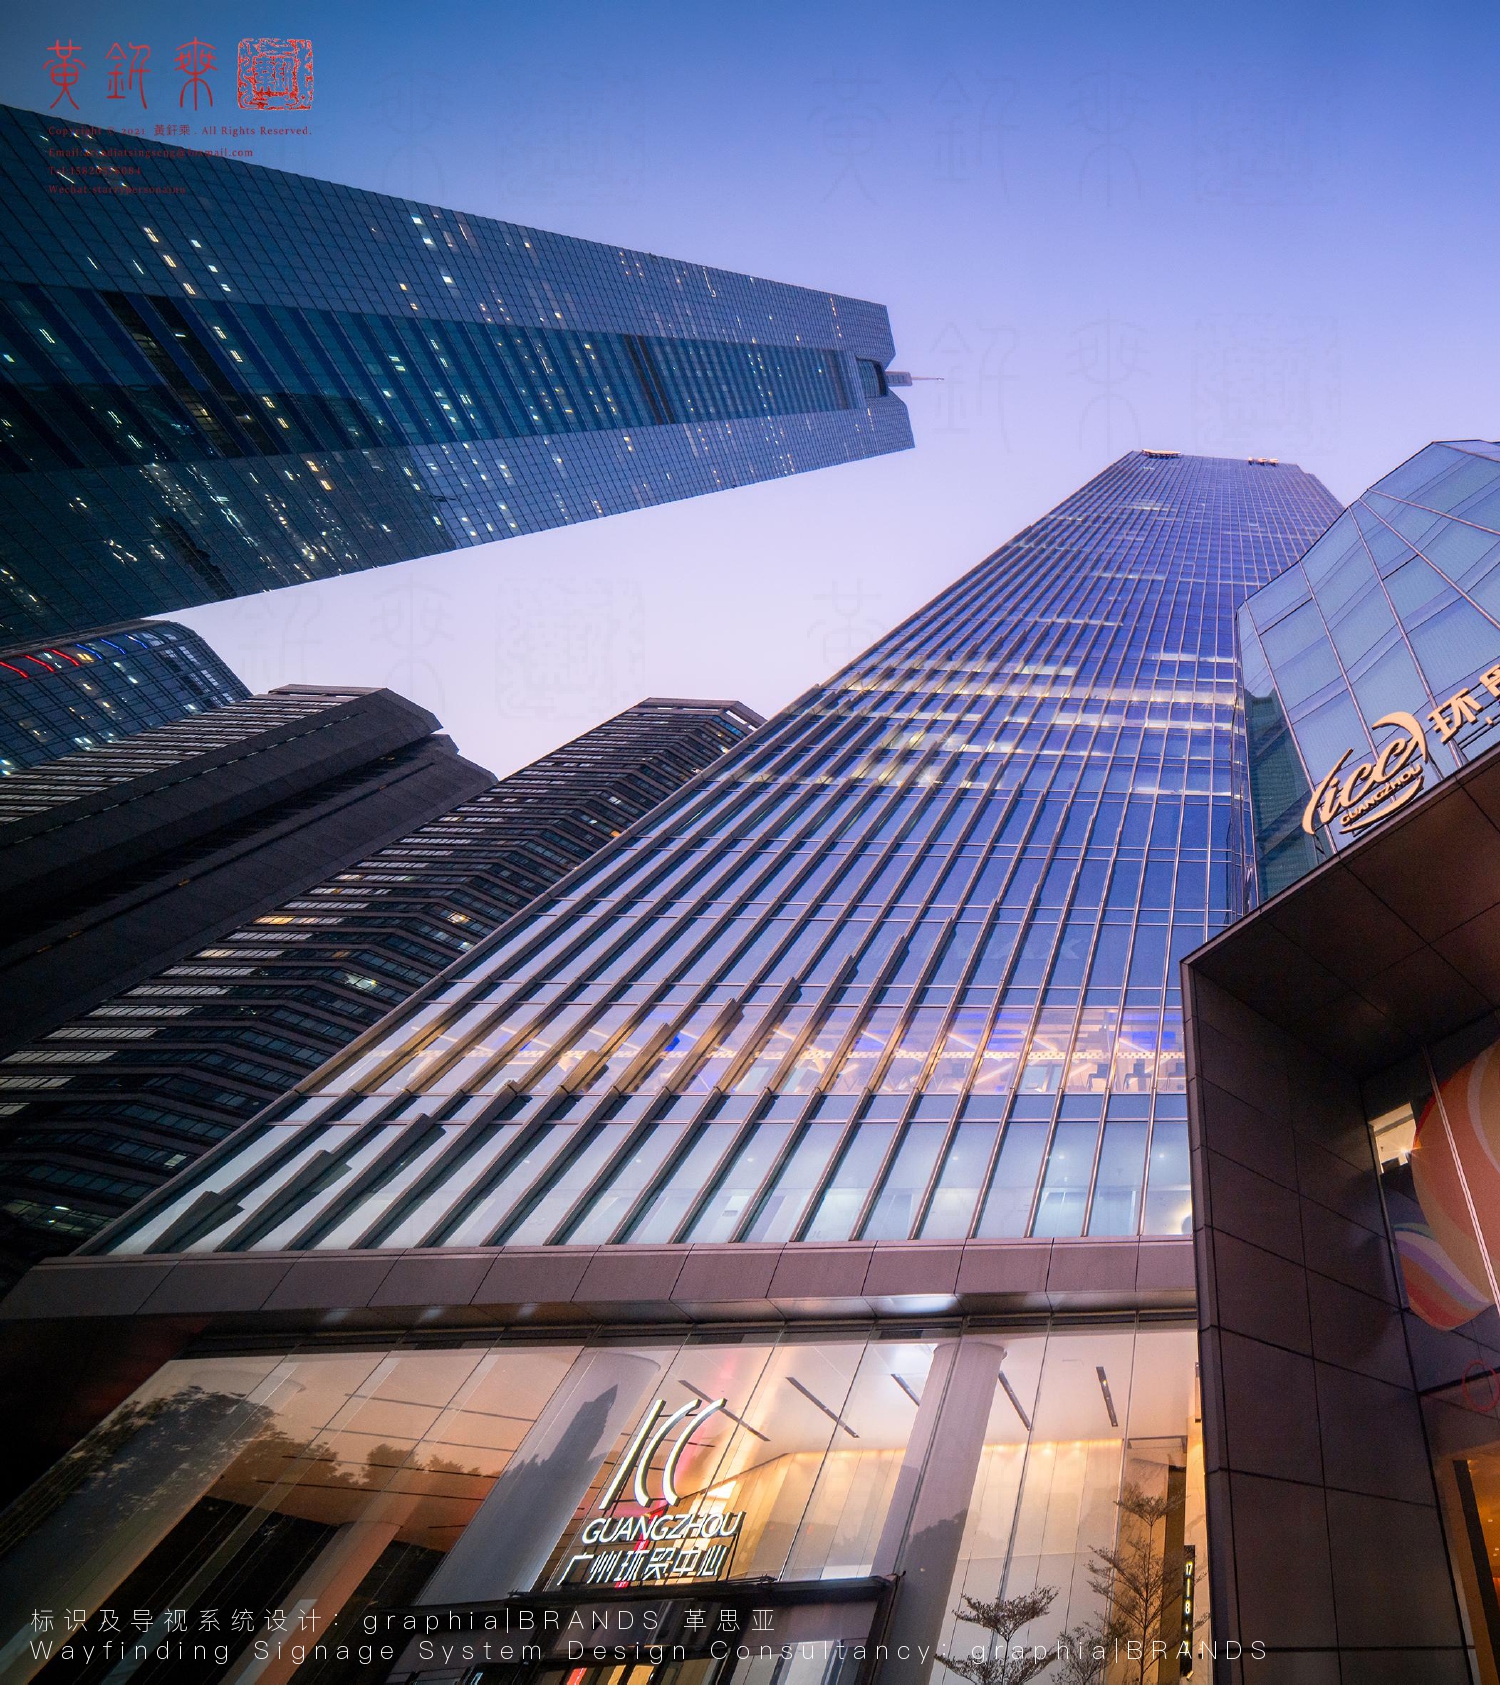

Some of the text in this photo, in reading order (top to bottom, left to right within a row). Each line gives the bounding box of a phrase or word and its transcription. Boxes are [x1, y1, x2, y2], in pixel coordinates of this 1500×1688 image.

[1341, 763, 1424, 827] GUANGZHOU
[581, 1510, 747, 1545] GUANGZHOU
[556, 1544, 731, 1587] 广州环贸中心
